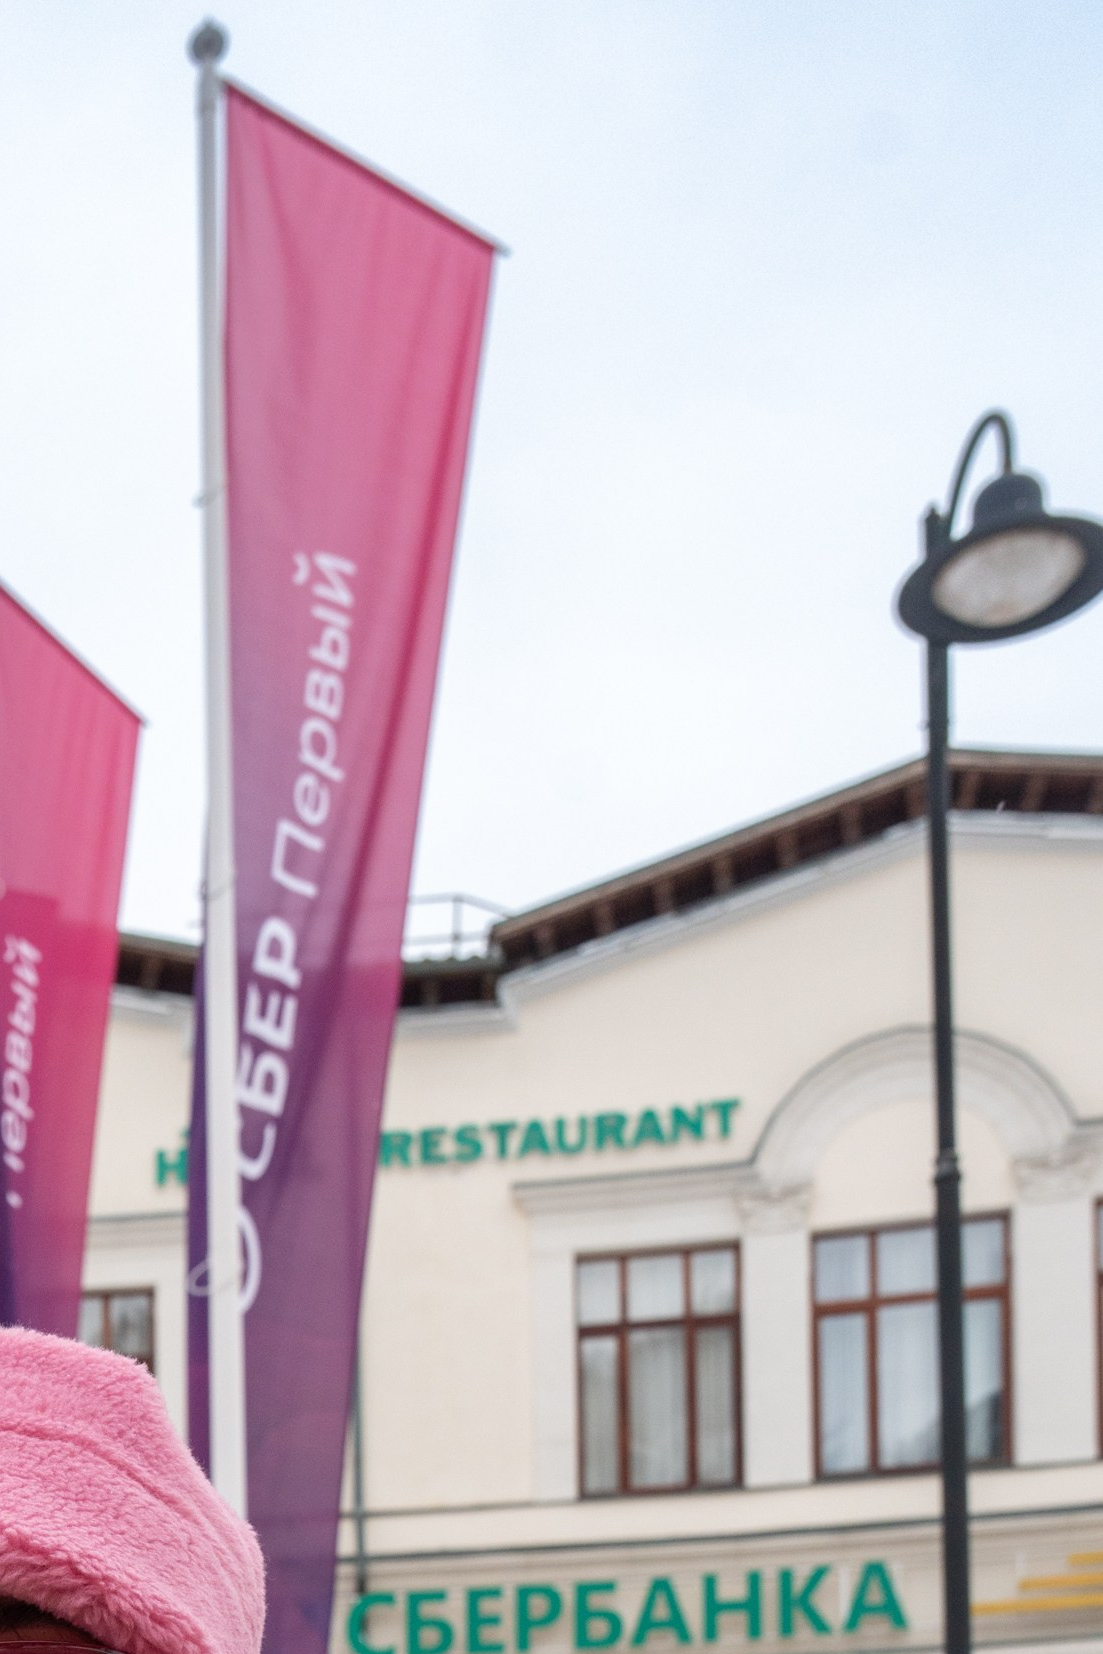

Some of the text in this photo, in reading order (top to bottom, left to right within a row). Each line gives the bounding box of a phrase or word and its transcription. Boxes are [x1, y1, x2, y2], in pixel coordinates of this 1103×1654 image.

[271, 551, 358, 899] Первый
[0, 934, 43, 1209] ервый
[379, 1098, 739, 1168] RESTAURANT
